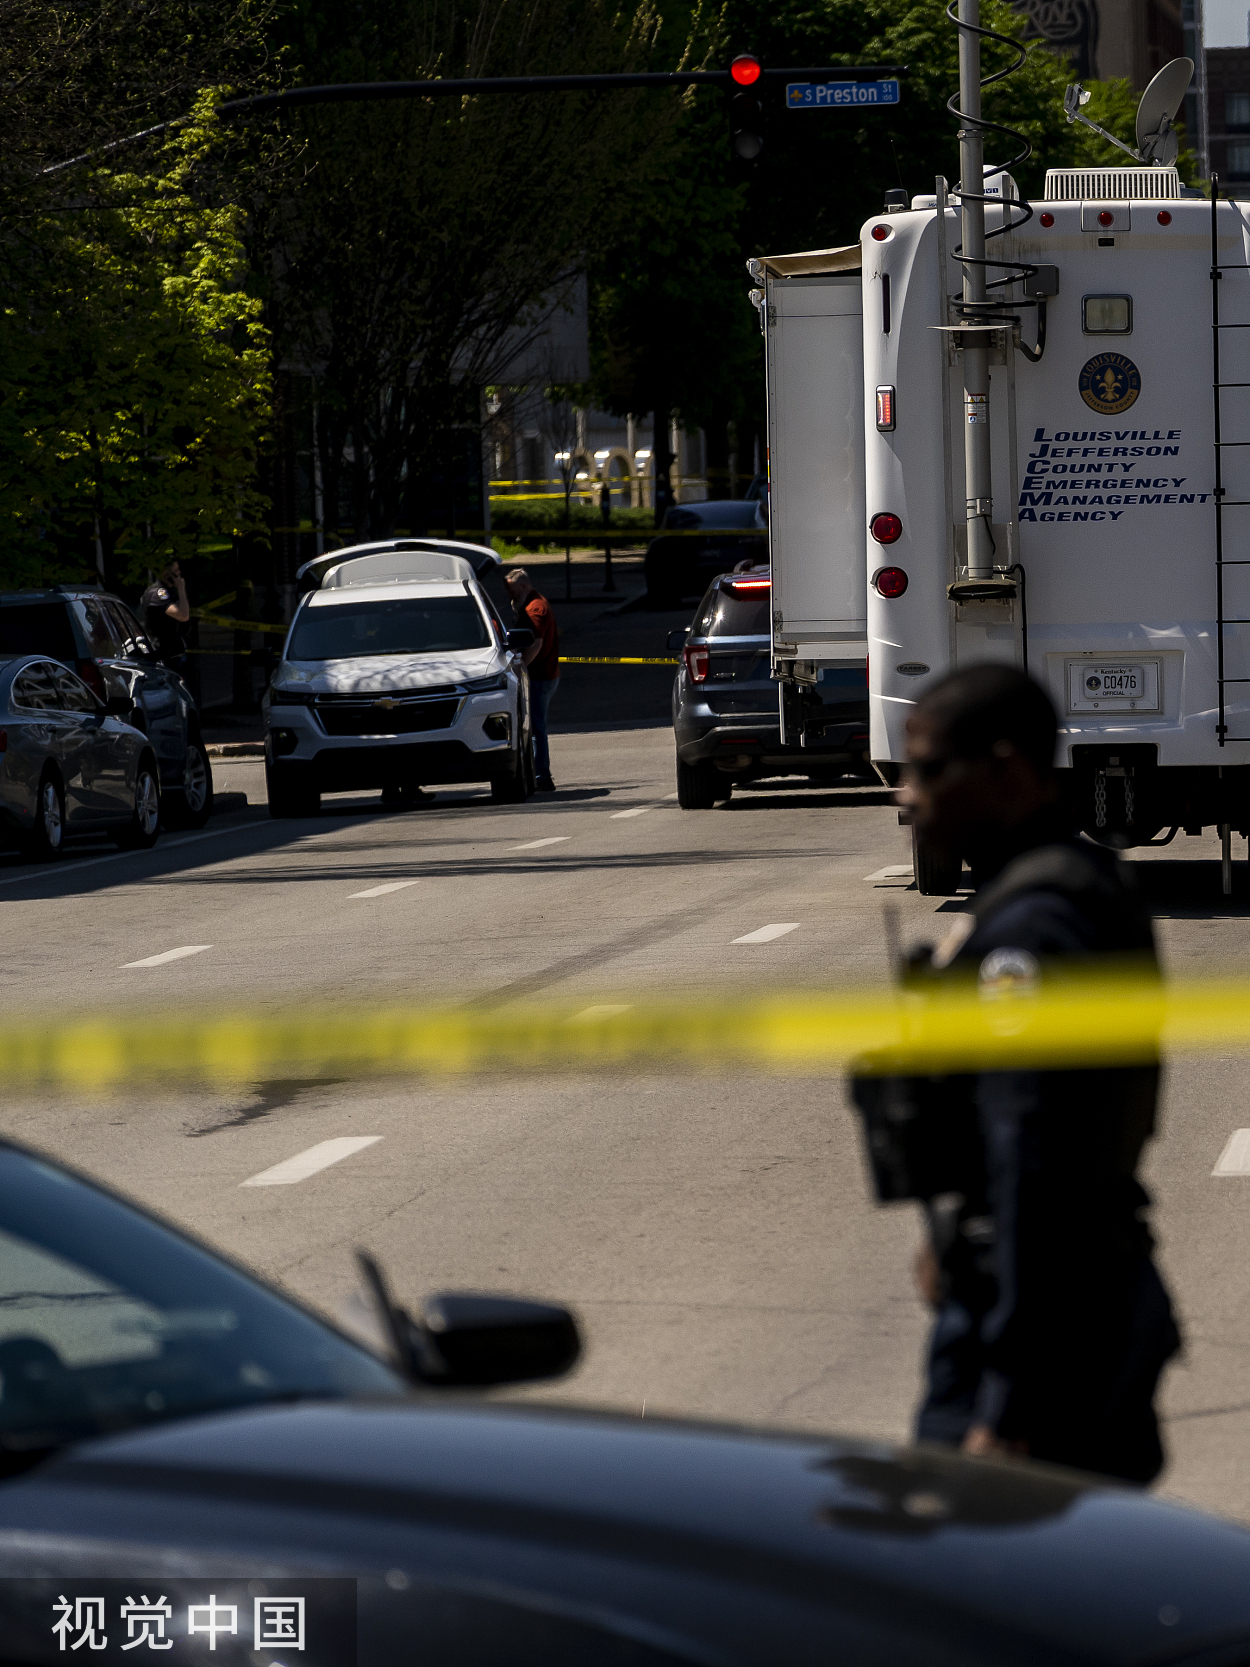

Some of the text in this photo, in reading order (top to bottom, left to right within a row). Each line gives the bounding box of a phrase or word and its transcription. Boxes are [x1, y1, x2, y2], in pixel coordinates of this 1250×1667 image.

[805, 83, 892, 103] S Preston St
[1082, 354, 1138, 377] LOUISVILLE
[1085, 391, 1135, 410] JEFFERSON COUNTY
[1033, 427, 1182, 442] LOUISVILLE
[1029, 443, 1180, 458] JEFFERSON
[1026, 459, 1136, 474] COUNTY
[1022, 476, 1187, 490] EMERGENCY
[1018, 491, 1212, 506] MANAGEMENT
[1018, 507, 1124, 522] AGENCY
